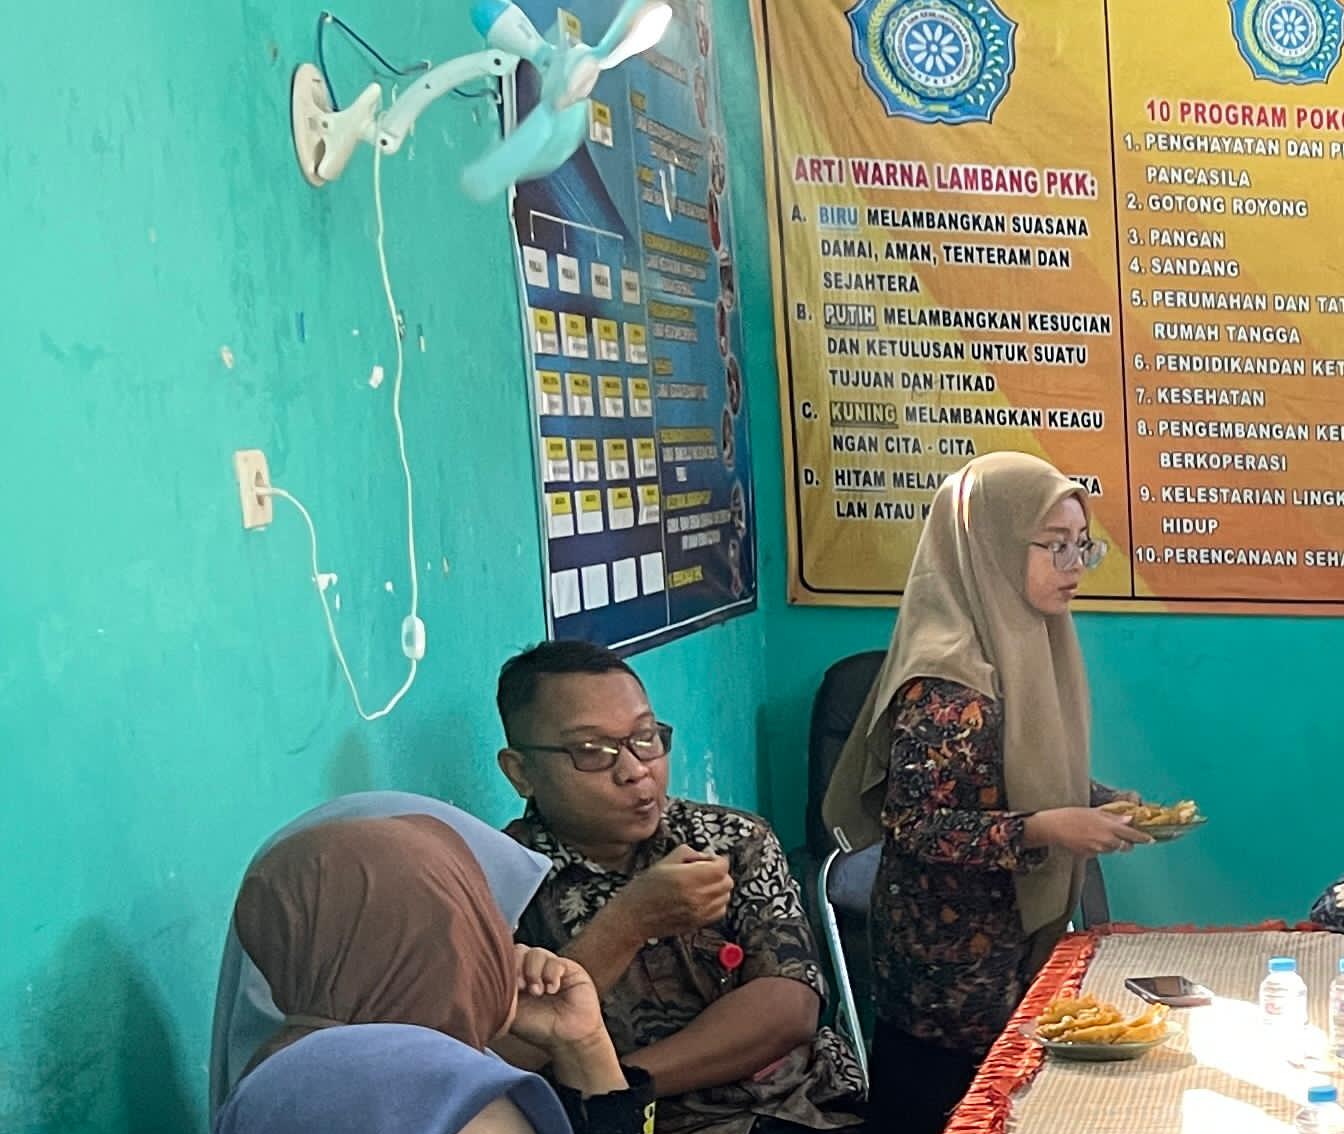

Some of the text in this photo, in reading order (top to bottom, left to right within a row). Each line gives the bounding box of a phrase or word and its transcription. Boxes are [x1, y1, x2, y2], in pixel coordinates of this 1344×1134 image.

[1147, 100, 1170, 121] 10
[1180, 102, 1286, 128] PROGRAM
[1124, 134, 1140, 151] 1.
[1145, 134, 1279, 156] PENGHAYATAN
[1287, 140, 1322, 158] DAN
[795, 158, 1096, 197] ARTI WARNA LAMBANG PKK:
[1147, 166, 1250, 187] PANCASILA
[1127, 193, 1308, 216] 2. GOTONG ROYONG
[820, 206, 1088, 236] BIRU MELAMBANGKAN SUASANA
[1128, 229, 1225, 248] 3. PANGAN
[821, 240, 1070, 268] DAMAI, AMAN, TENTERAM DAN
[1129, 257, 1239, 277] 4. SANDANG
[823, 272, 919, 292] SEJAHTERA
[1131, 290, 1147, 306] 5.
[1153, 290, 1267, 311] PERUMAHAN
[1275, 294, 1310, 312] DAN
[824, 304, 1111, 333] PUTIH MELAMBANGKAN KESUCIAN
[1154, 323, 1301, 343] RUMAH TANGGA
[828, 337, 1086, 363] DAN KETULUSAN UNTUK SUATU
[1134, 354, 1149, 370] 6.
[830, 369, 995, 392] TUJUAN DAN ITIKAD
[1136, 388, 1265, 407] 7. KESEHATAN
[830, 402, 1103, 429] KUNING MELAMBANGKAN KEAGU
[1137, 420, 1152, 436] 8.
[1159, 421, 1308, 440] PENGEMBANGAN
[833, 435, 975, 455] NGAN CITA CITA
[1160, 453, 1287, 471] BERKOPERASI
[835, 469, 886, 488] HITAM
[1140, 486, 1155, 502] 9.
[1162, 487, 1285, 505] KELESTARIAN
[837, 501, 867, 519] LAN
[875, 503, 914, 520] ATAU
[1163, 518, 1218, 534] HIDUP
